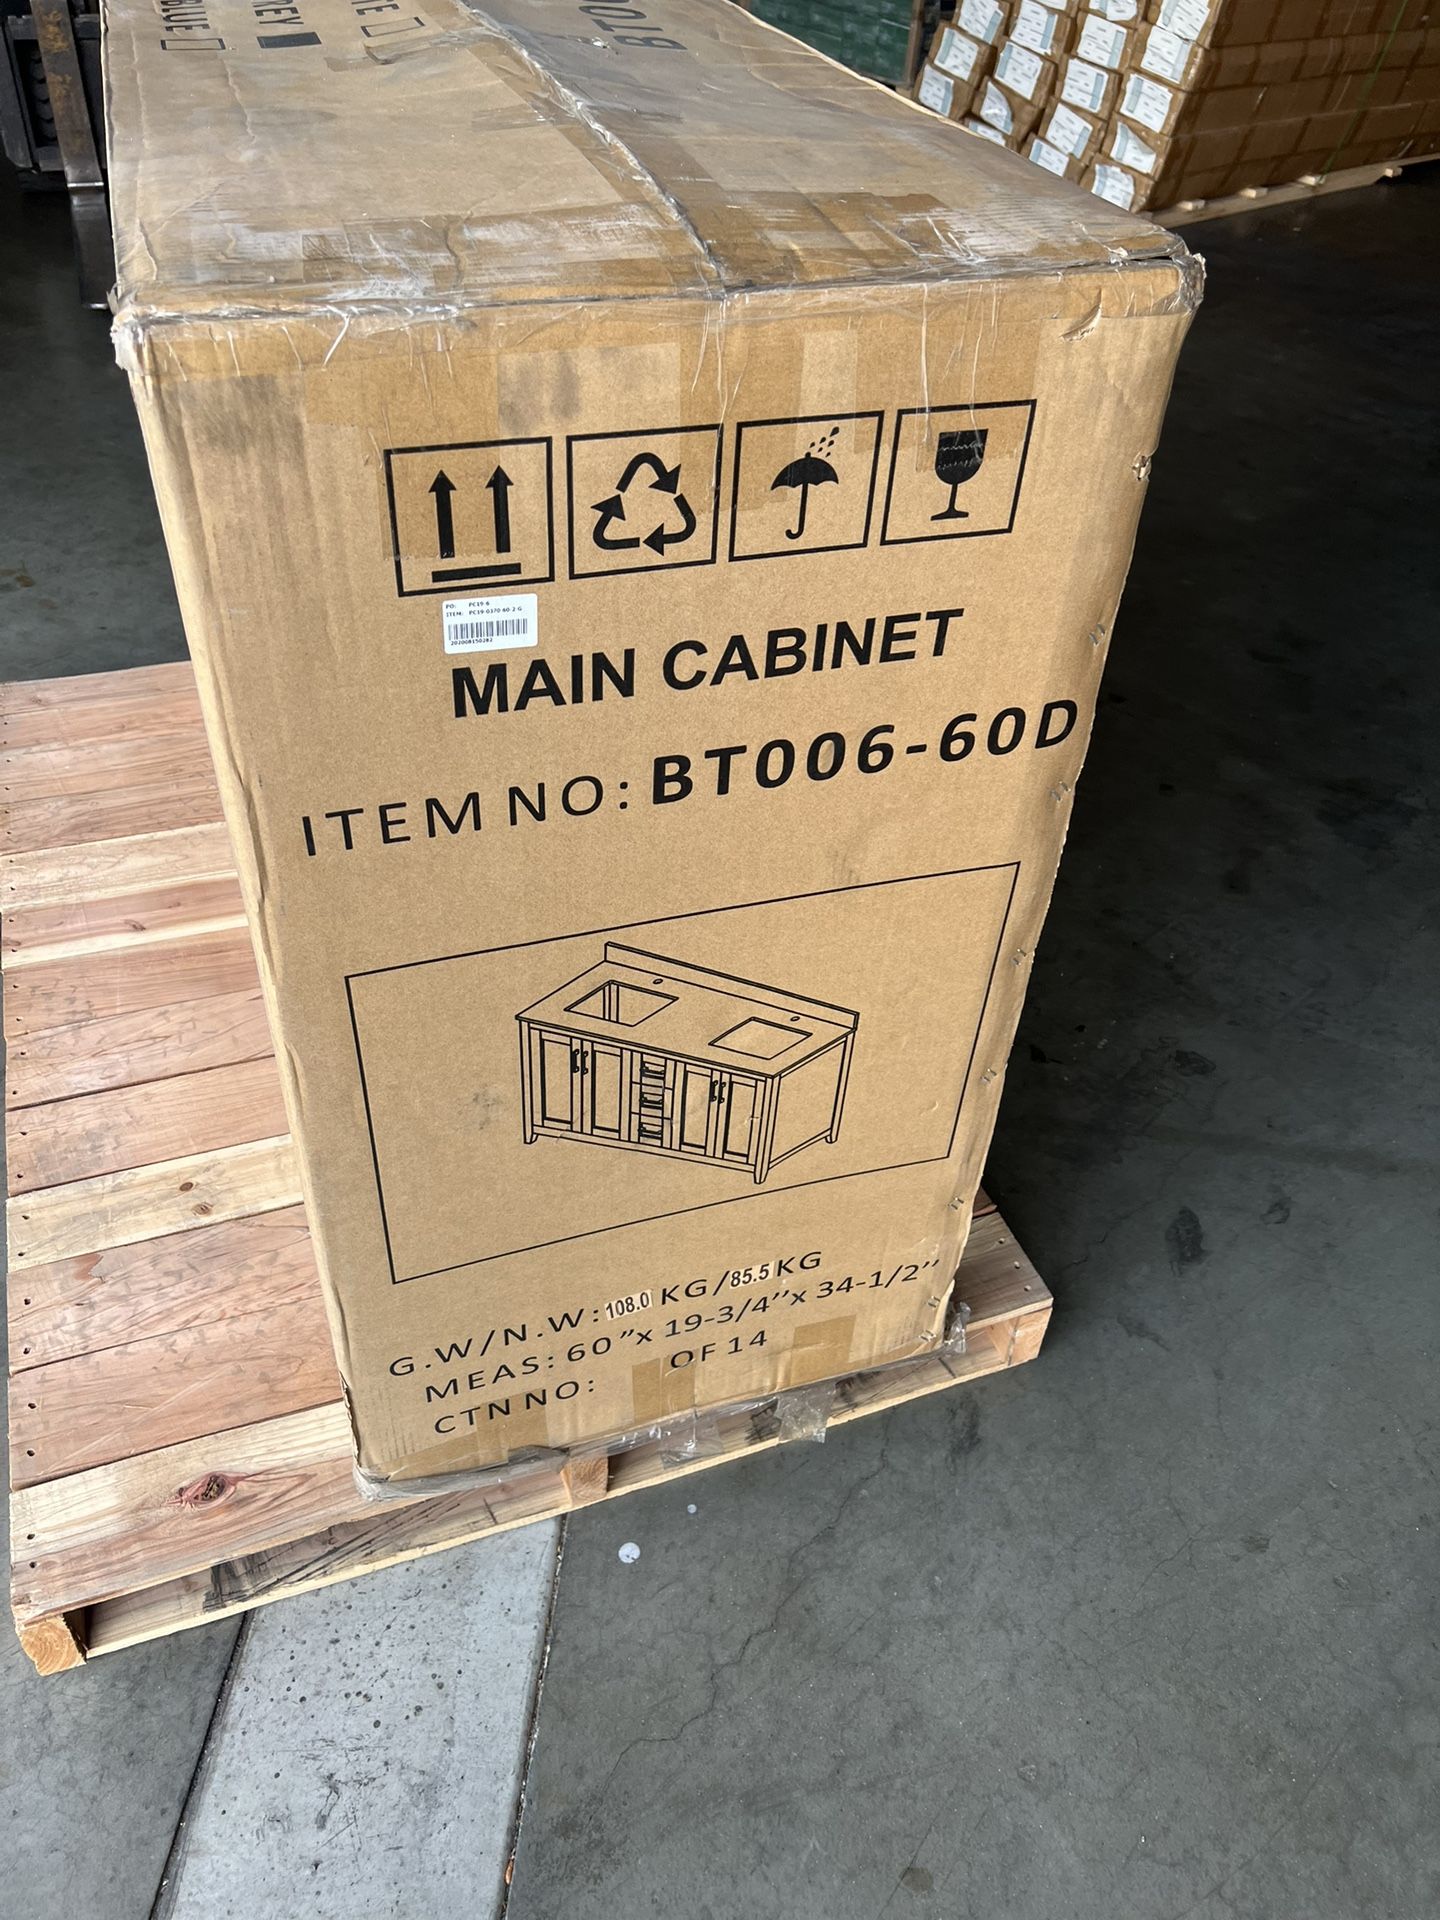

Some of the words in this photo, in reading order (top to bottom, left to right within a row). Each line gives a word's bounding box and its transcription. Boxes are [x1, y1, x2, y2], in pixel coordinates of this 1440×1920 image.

[452, 649, 635, 718] MAIN
[662, 608, 965, 691] CABINET
[302, 792, 482, 857] ITEM
[508, 775, 631, 826] NO:
[652, 700, 1078, 805] BT006-60D
[425, 1352, 554, 1403] MEAS:
[434, 1388, 512, 1434] CTN
[525, 1379, 594, 1411] NO:
[669, 1342, 717, 1370] OF
[727, 1330, 767, 1355] 14
